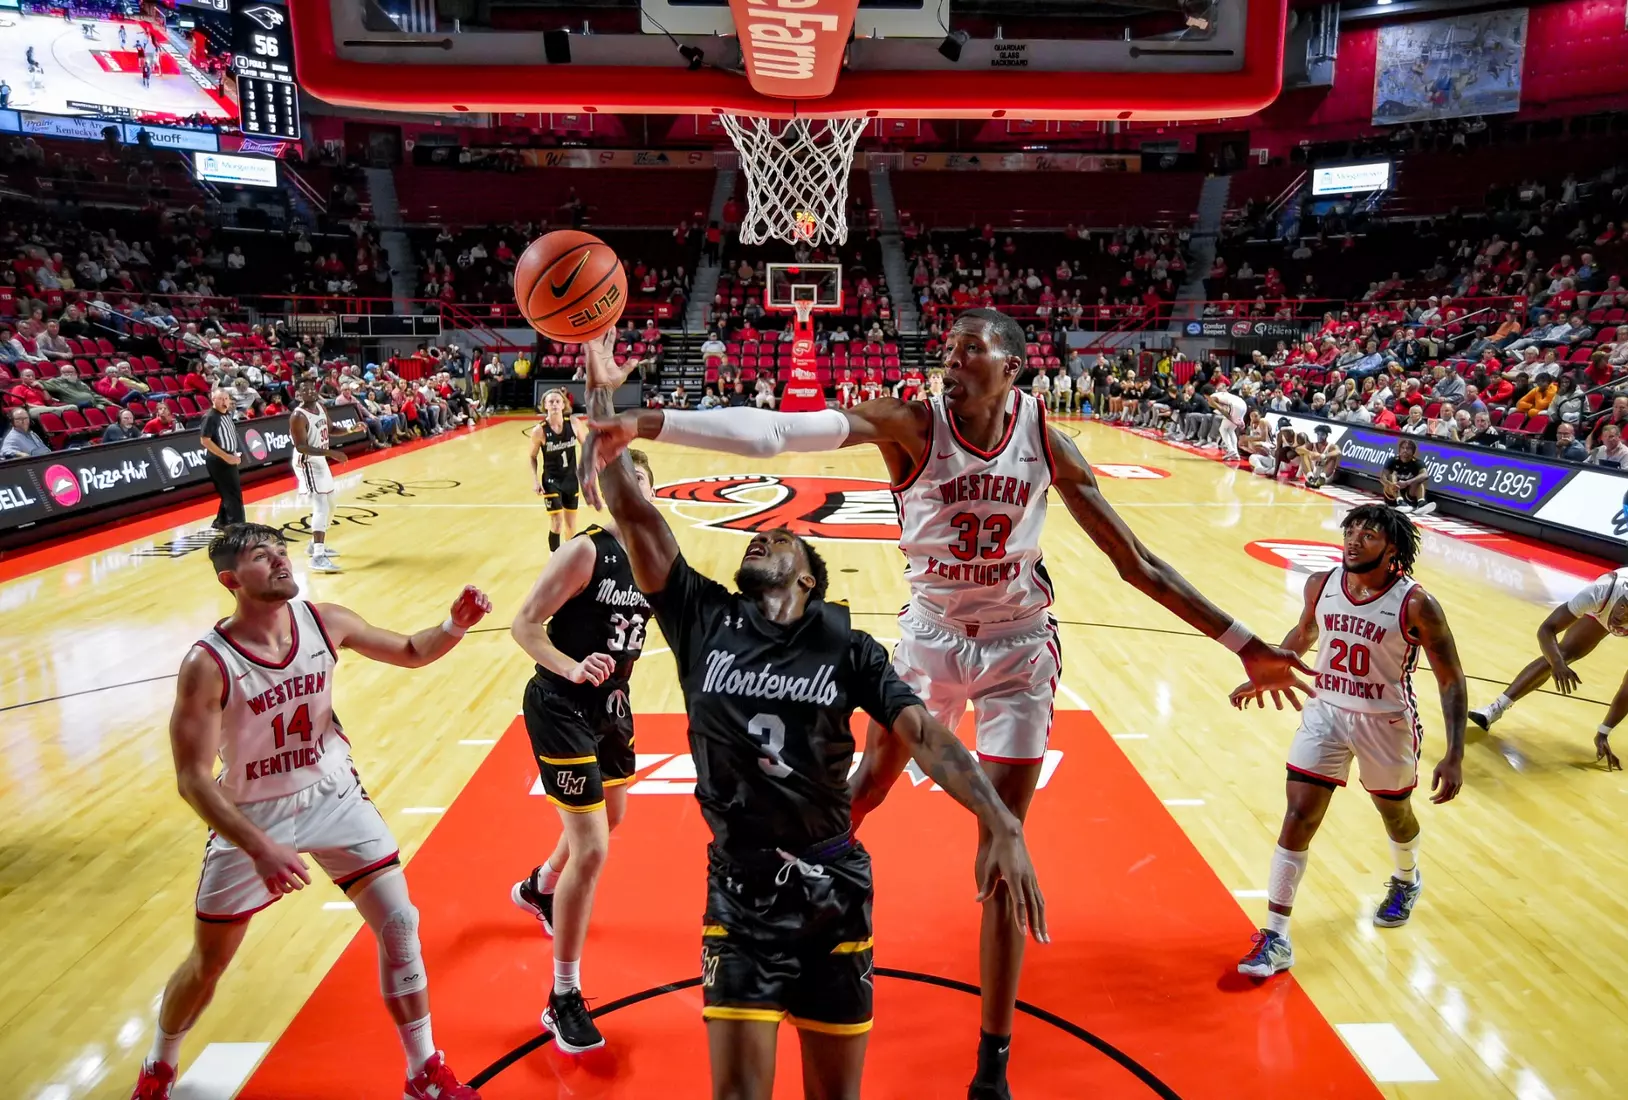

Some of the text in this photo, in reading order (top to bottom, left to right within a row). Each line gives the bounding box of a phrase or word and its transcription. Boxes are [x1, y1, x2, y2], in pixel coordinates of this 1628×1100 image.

[254, 34, 279, 57] 56
[747, 7, 839, 80] Farm
[248, 91, 255, 100] 3
[267, 94, 274, 103] 7
[249, 101, 256, 110] 4
[285, 86, 292, 95] 2
[74, 118, 87, 128] We
[90, 121, 104, 129] Are
[149, 132, 181, 144] Ruoff
[567, 283, 620, 328] ELITE
[1203, 322, 1227, 330] Comfort
[182, 448, 208, 468] TAC
[561, 451, 568, 468] 1
[1342, 439, 1396, 465] Communit
[1448, 461, 1488, 488] Since
[1489, 469, 1536, 499] 1895
[79, 460, 150, 495] Pizza Hut
[939, 474, 1032, 508] WESTERN
[0, 486, 35, 511] ELL
[948, 511, 1012, 561] 33
[924, 556, 1021, 586] KENTUCKY
[607, 613, 645, 652] 32
[1323, 613, 1387, 644] WESTERN
[1329, 637, 1371, 677] 20
[246, 671, 327, 716] WESTERN
[702, 649, 838, 706] Montevallo
[1315, 672, 1385, 700] KENTUCKY
[271, 702, 313, 749] 14
[246, 733, 326, 781] KENTUCKY
[747, 712, 794, 778] 3
[556, 770, 587, 795] UM
[701, 945, 720, 987] M
